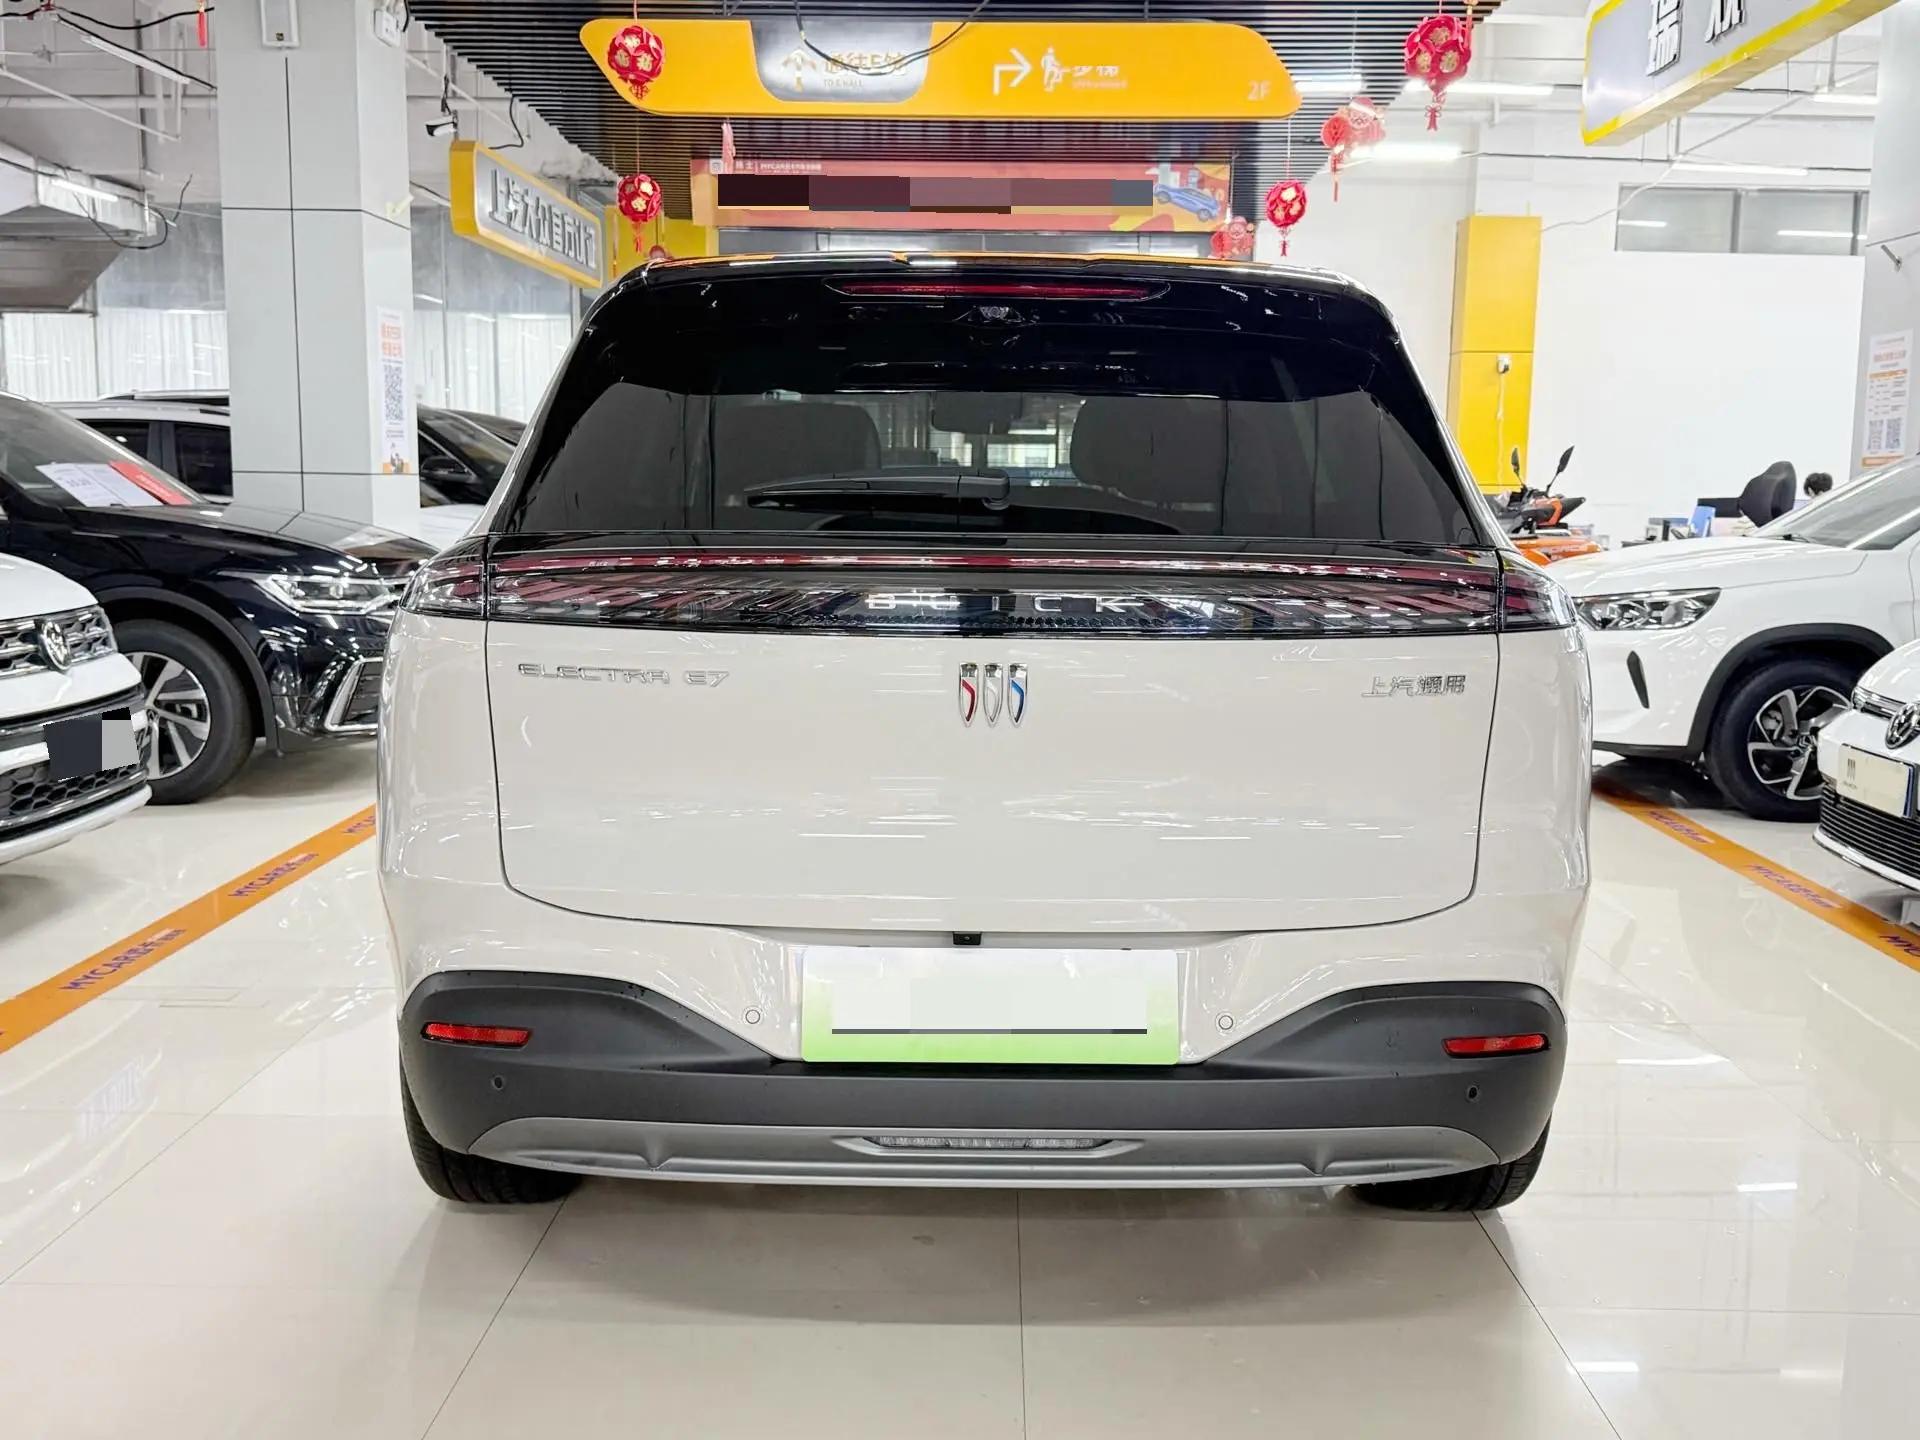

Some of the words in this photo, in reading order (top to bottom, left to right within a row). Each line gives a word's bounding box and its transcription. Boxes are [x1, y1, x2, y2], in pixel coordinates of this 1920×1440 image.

[1247, 80, 1271, 101] 2F
[866, 594, 1137, 613] BUICK
[518, 663, 671, 685] ELECTRA
[685, 669, 730, 688] E7
[1360, 674, 1467, 698] 上汽通用
